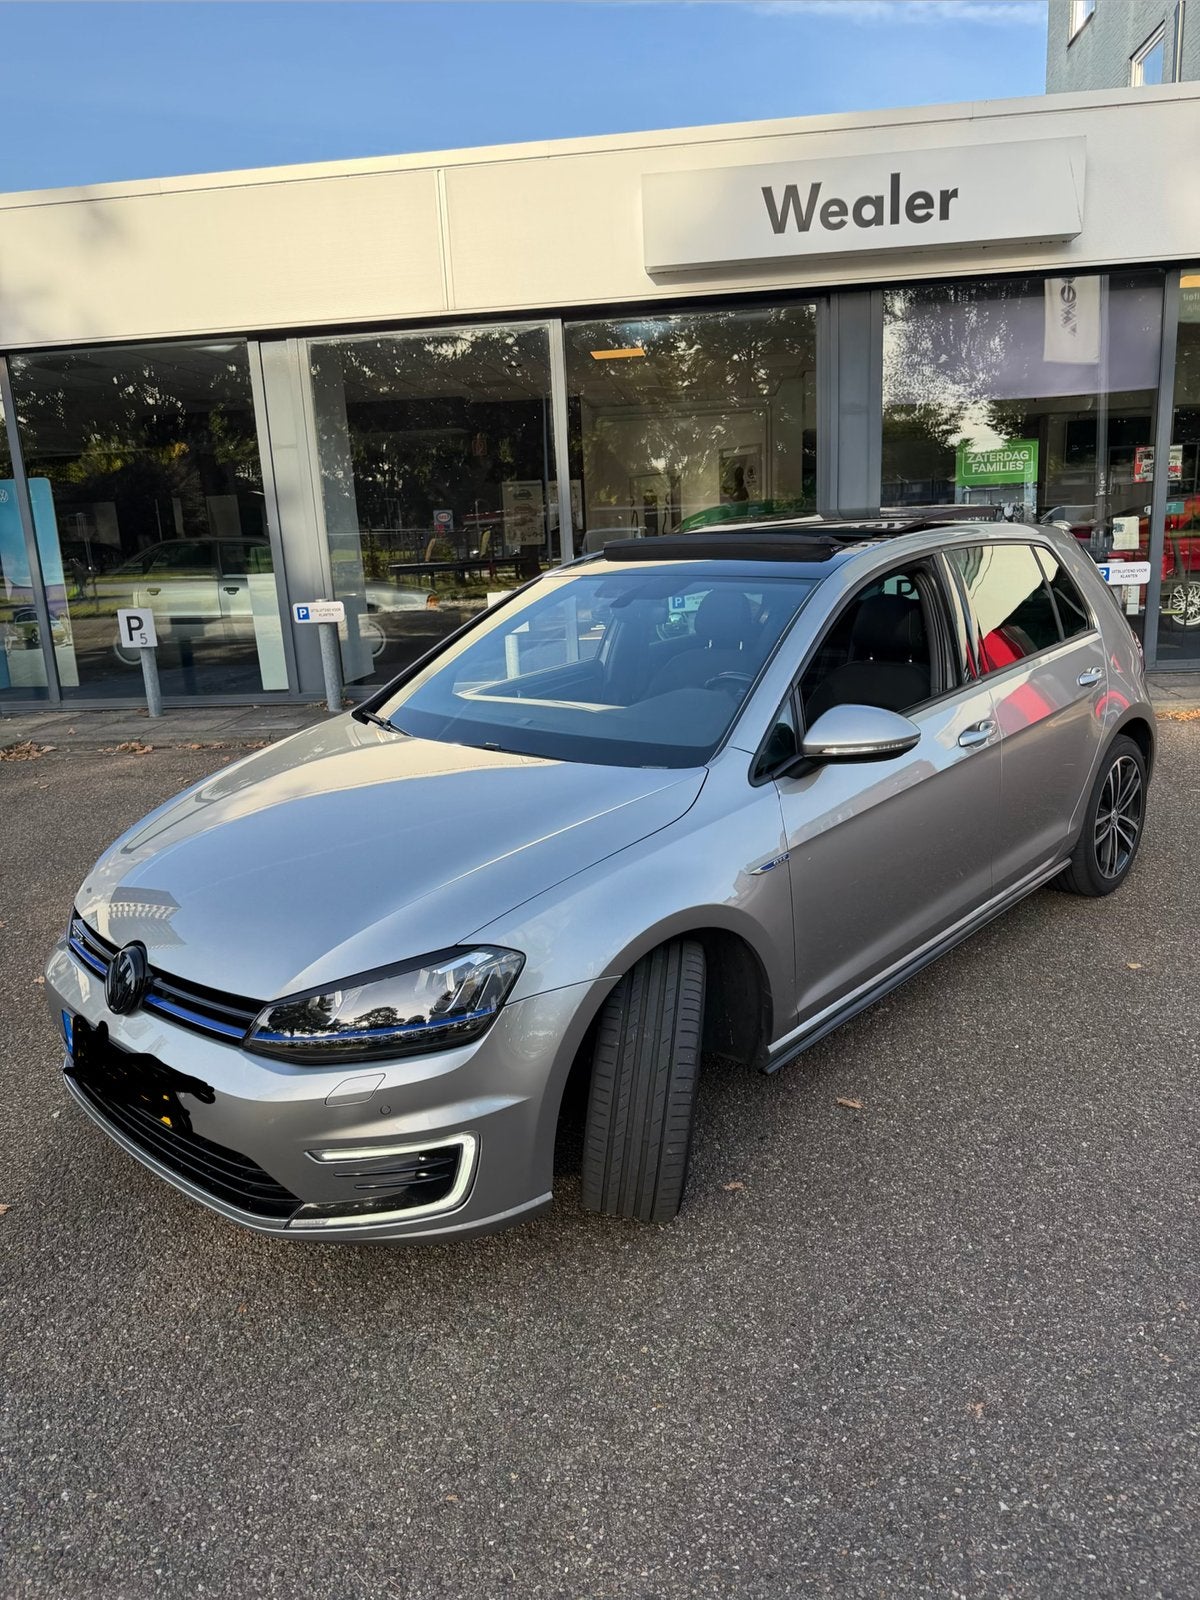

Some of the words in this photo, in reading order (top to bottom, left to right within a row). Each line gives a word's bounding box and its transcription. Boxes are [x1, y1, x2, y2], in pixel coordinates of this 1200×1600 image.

[761, 172, 959, 235] Wealer
[967, 450, 1029, 463] ZATERDAG
[971, 461, 1024, 473] FAMILIES
[299, 608, 307, 618] P
